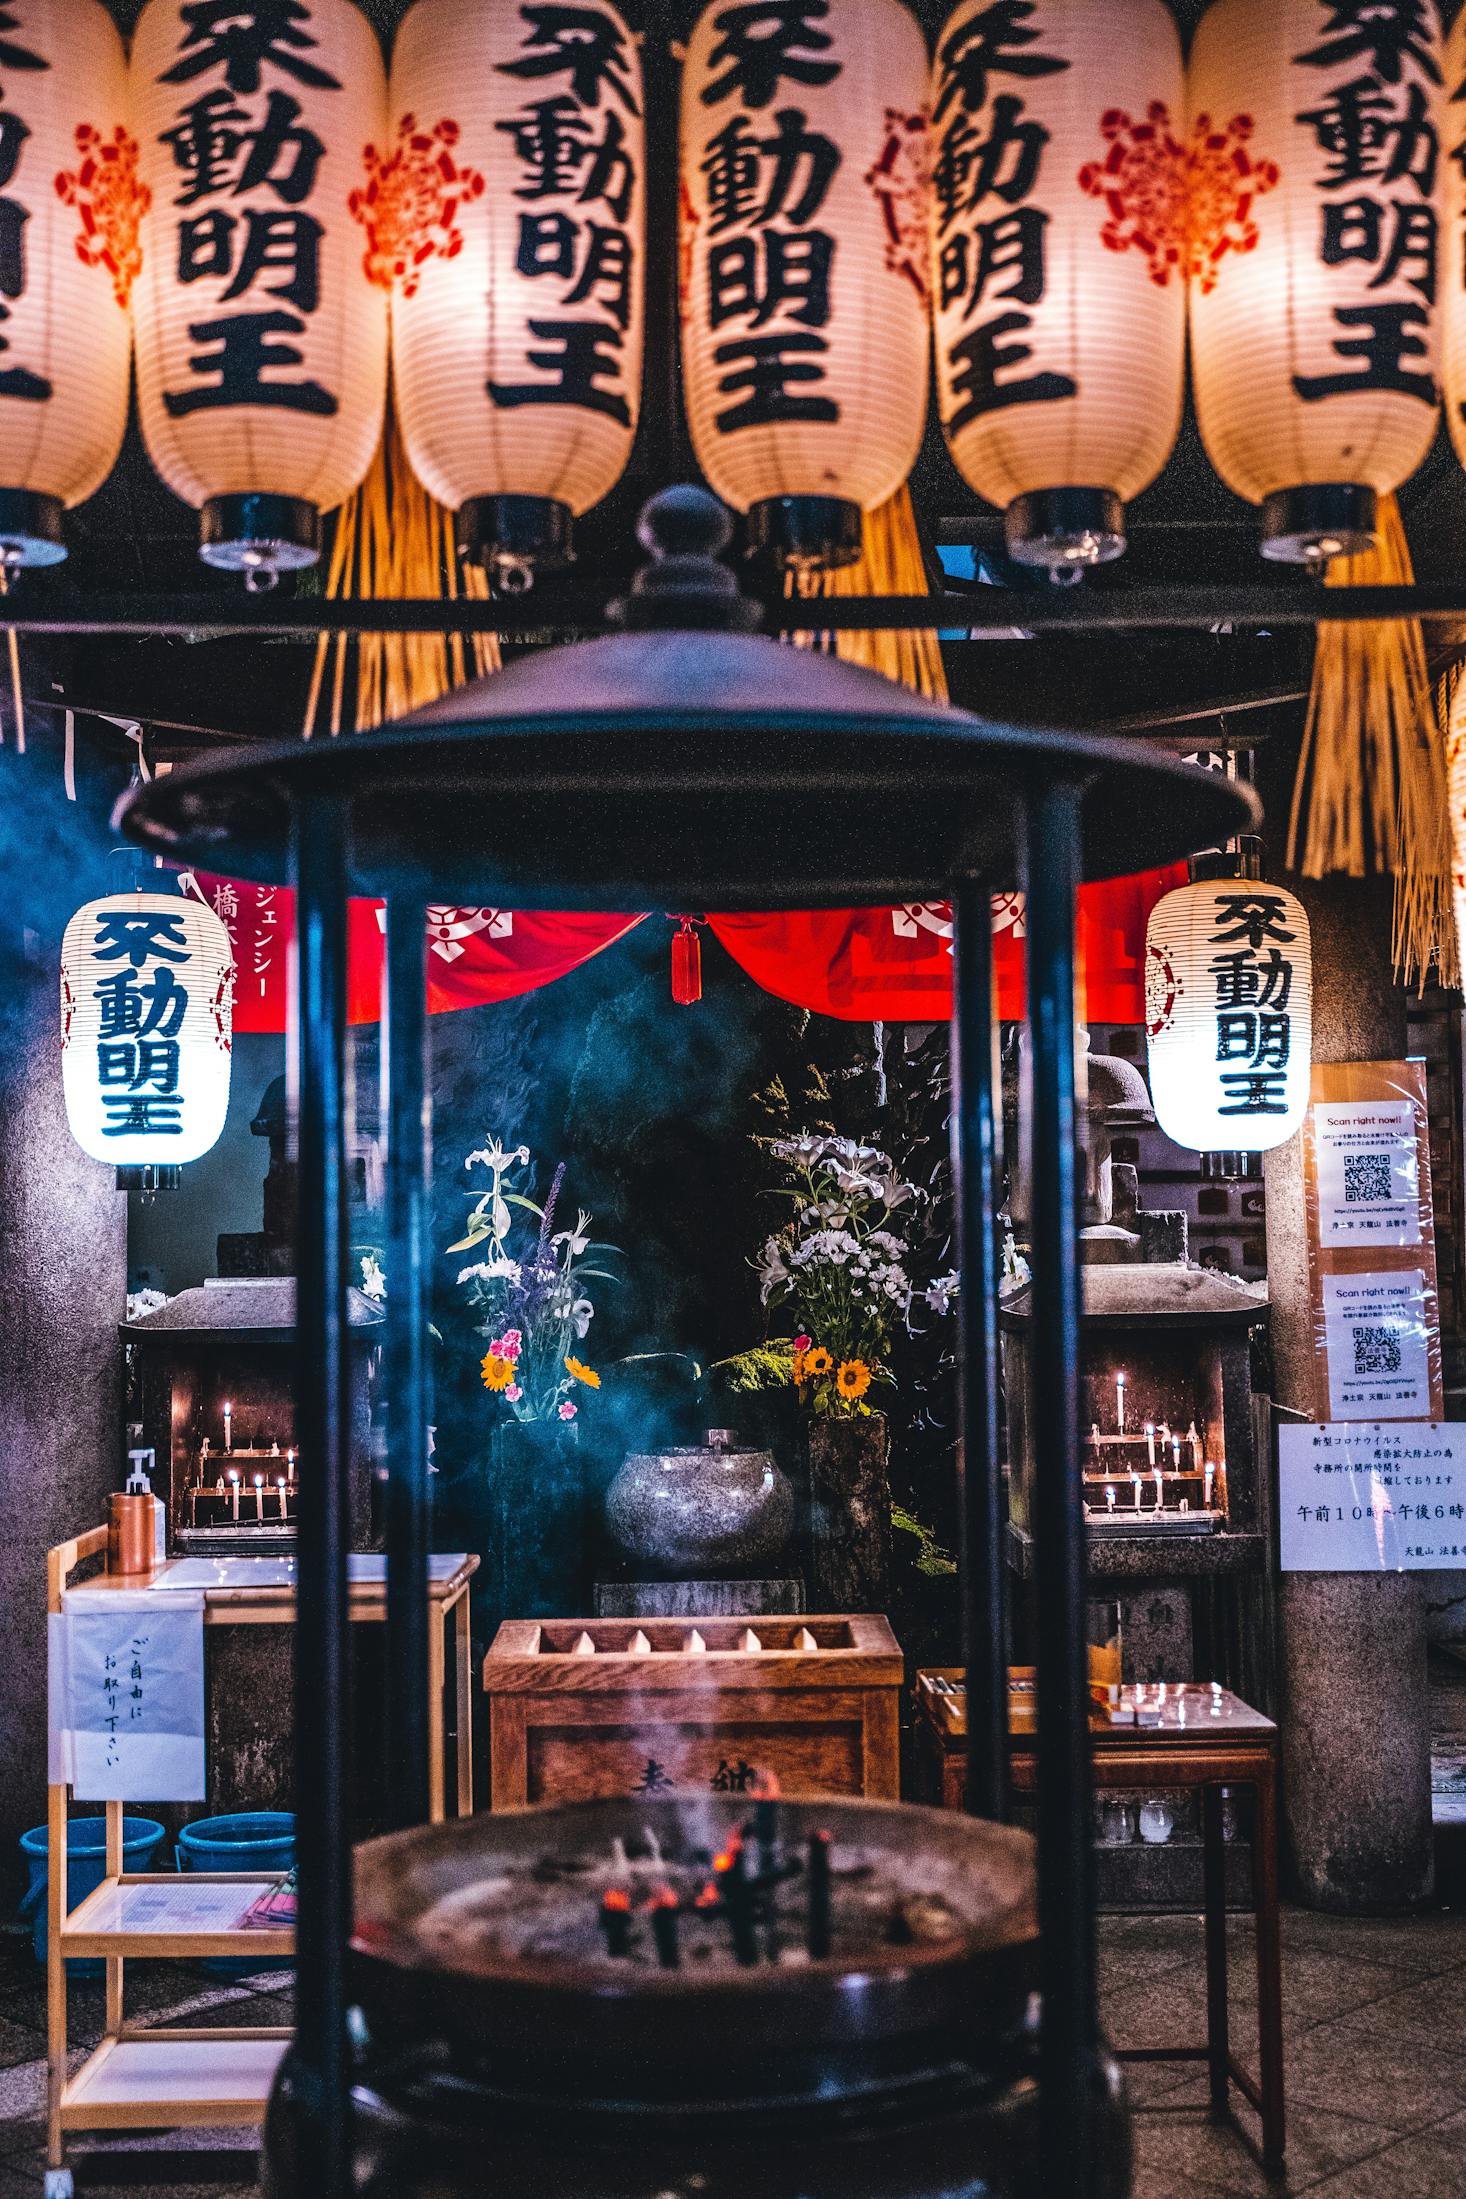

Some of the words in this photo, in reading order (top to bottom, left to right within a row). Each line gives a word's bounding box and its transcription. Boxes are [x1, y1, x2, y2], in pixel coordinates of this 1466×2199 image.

[159, 0, 342, 417] 不動明王
[487, 3, 641, 429] 不動明王
[699, 0, 845, 434] 不動明王
[254, 886, 278, 997] ジェンシー
[90, 911, 192, 1136] 不動明王
[1207, 894, 1297, 1116] 不動明王
[1327, 1118, 1351, 1126] Scan
[1353, 1116, 1376, 1126] right
[1336, 1289, 1360, 1298] Scan
[1362, 1287, 1385, 1298] right
[1312, 1436, 1401, 1447] 新型コロナウイルス
[1373, 1448, 1453, 1460] 感染拡大防止の為
[1375, 1475, 1453, 1486] 縮しております
[103, 1654, 120, 1768] お取り下さい
[130, 1636, 149, 1719] ご自由に
